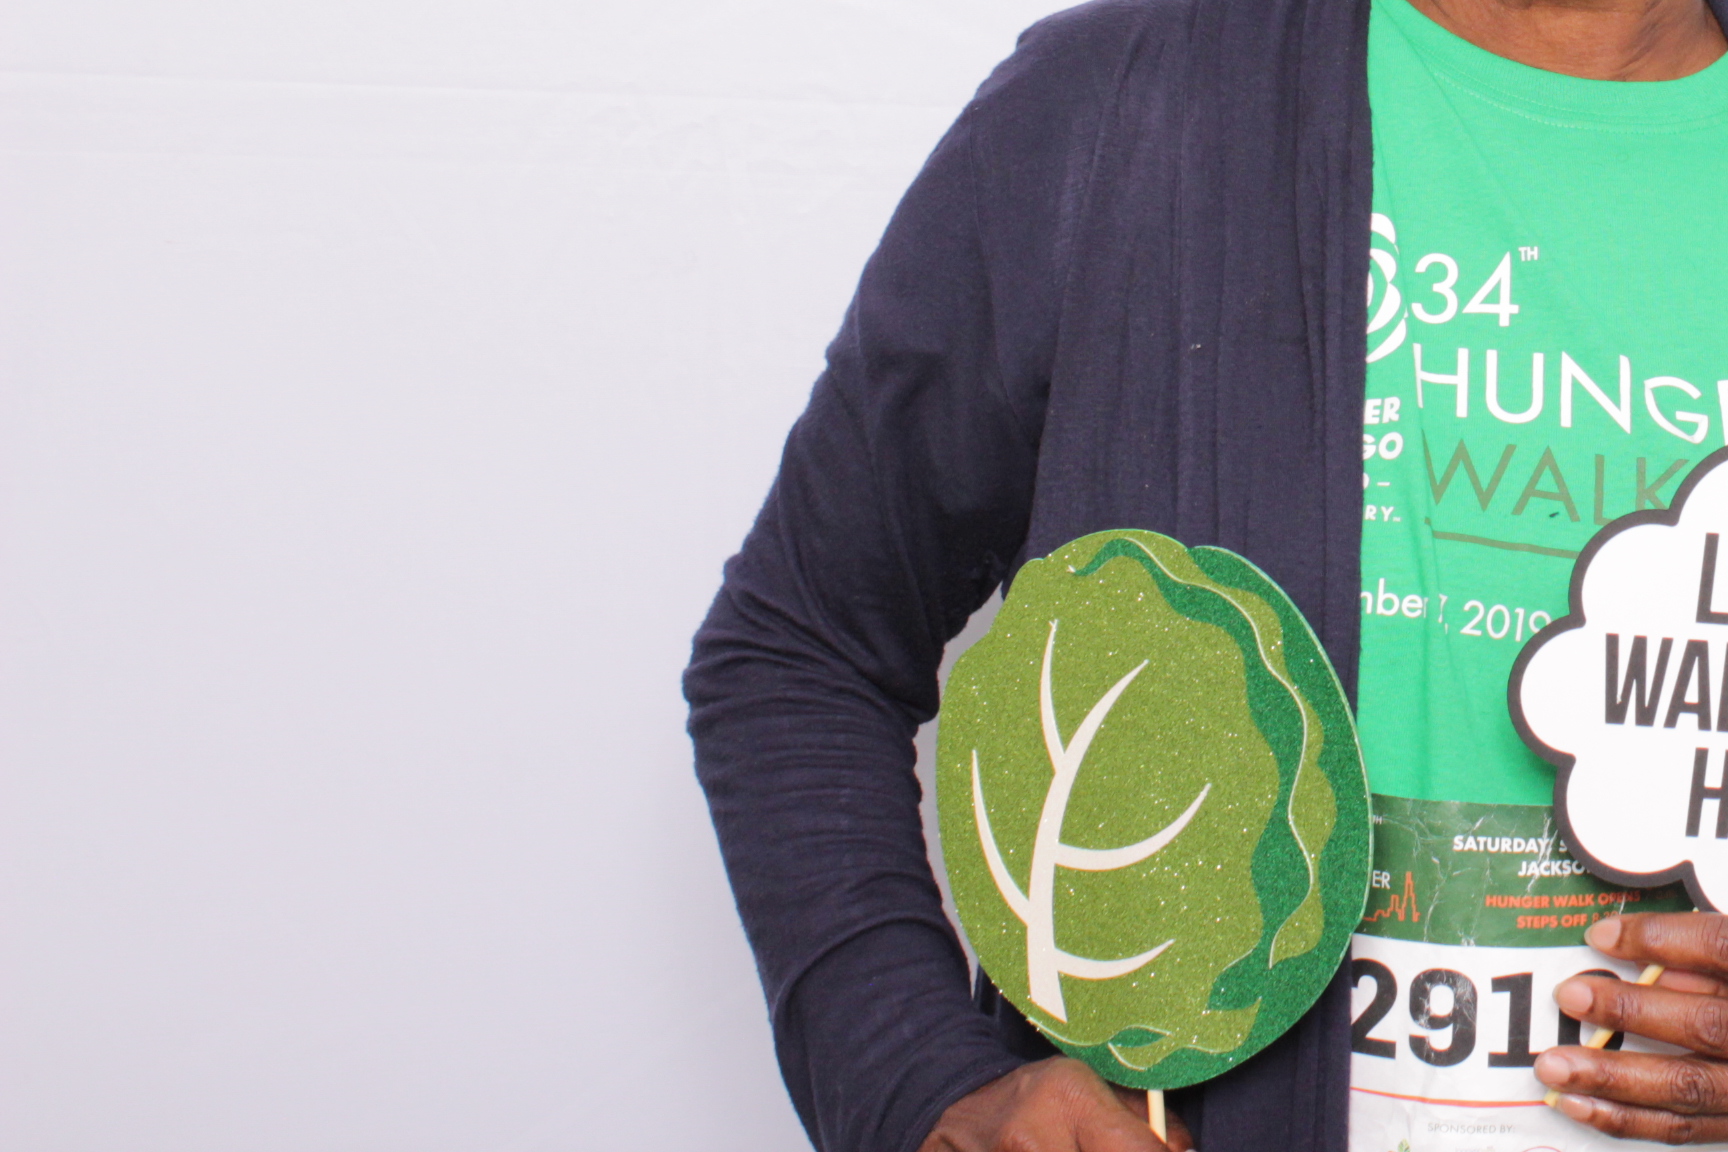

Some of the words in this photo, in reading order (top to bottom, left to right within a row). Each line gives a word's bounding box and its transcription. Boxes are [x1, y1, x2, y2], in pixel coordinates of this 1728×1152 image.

[1421, 428, 1690, 525] WALK
[1517, 859, 1591, 877] JACKSO
[1485, 895, 1550, 909] HUNGER
[1553, 893, 1595, 908] WALK
[1516, 914, 1558, 929] STEPS
[1560, 912, 1588, 928] OFF
[1427, 1122, 1497, 1134] SPONSORED
